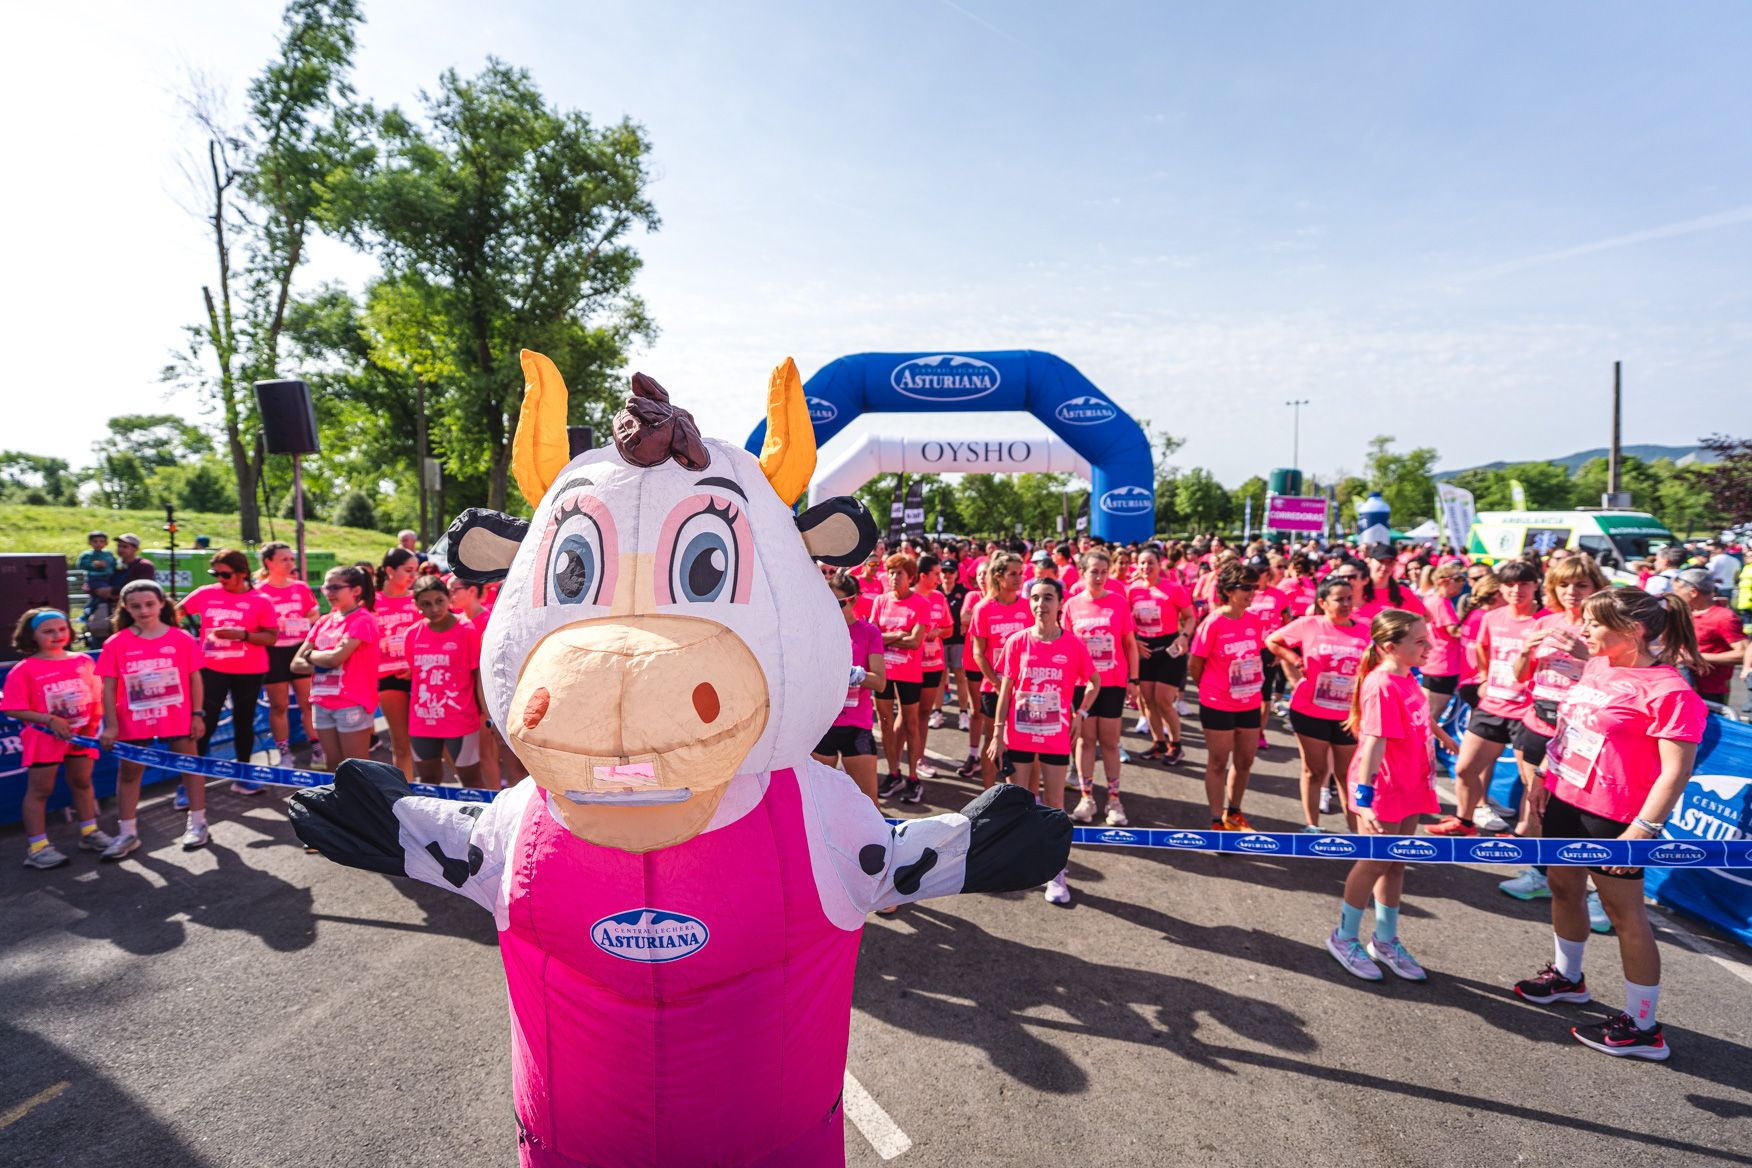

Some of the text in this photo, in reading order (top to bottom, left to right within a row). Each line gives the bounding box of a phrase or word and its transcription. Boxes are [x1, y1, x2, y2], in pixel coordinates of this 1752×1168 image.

[900, 368, 991, 388] ASTURIANA
[1062, 408, 1113, 418] ASTURIANA
[921, 440, 1032, 463] OYSHO
[430, 669, 444, 685] DE
[1392, 846, 1433, 855] ASTURIANA
[1475, 848, 1519, 857] ASTURIANA
[1562, 849, 1608, 858] ASTURIANA
[1654, 851, 1702, 859] ASTURIANA
[614, 925, 695, 935] CENTRAL LECHERA
[600, 927, 701, 949] ASTURIANA
